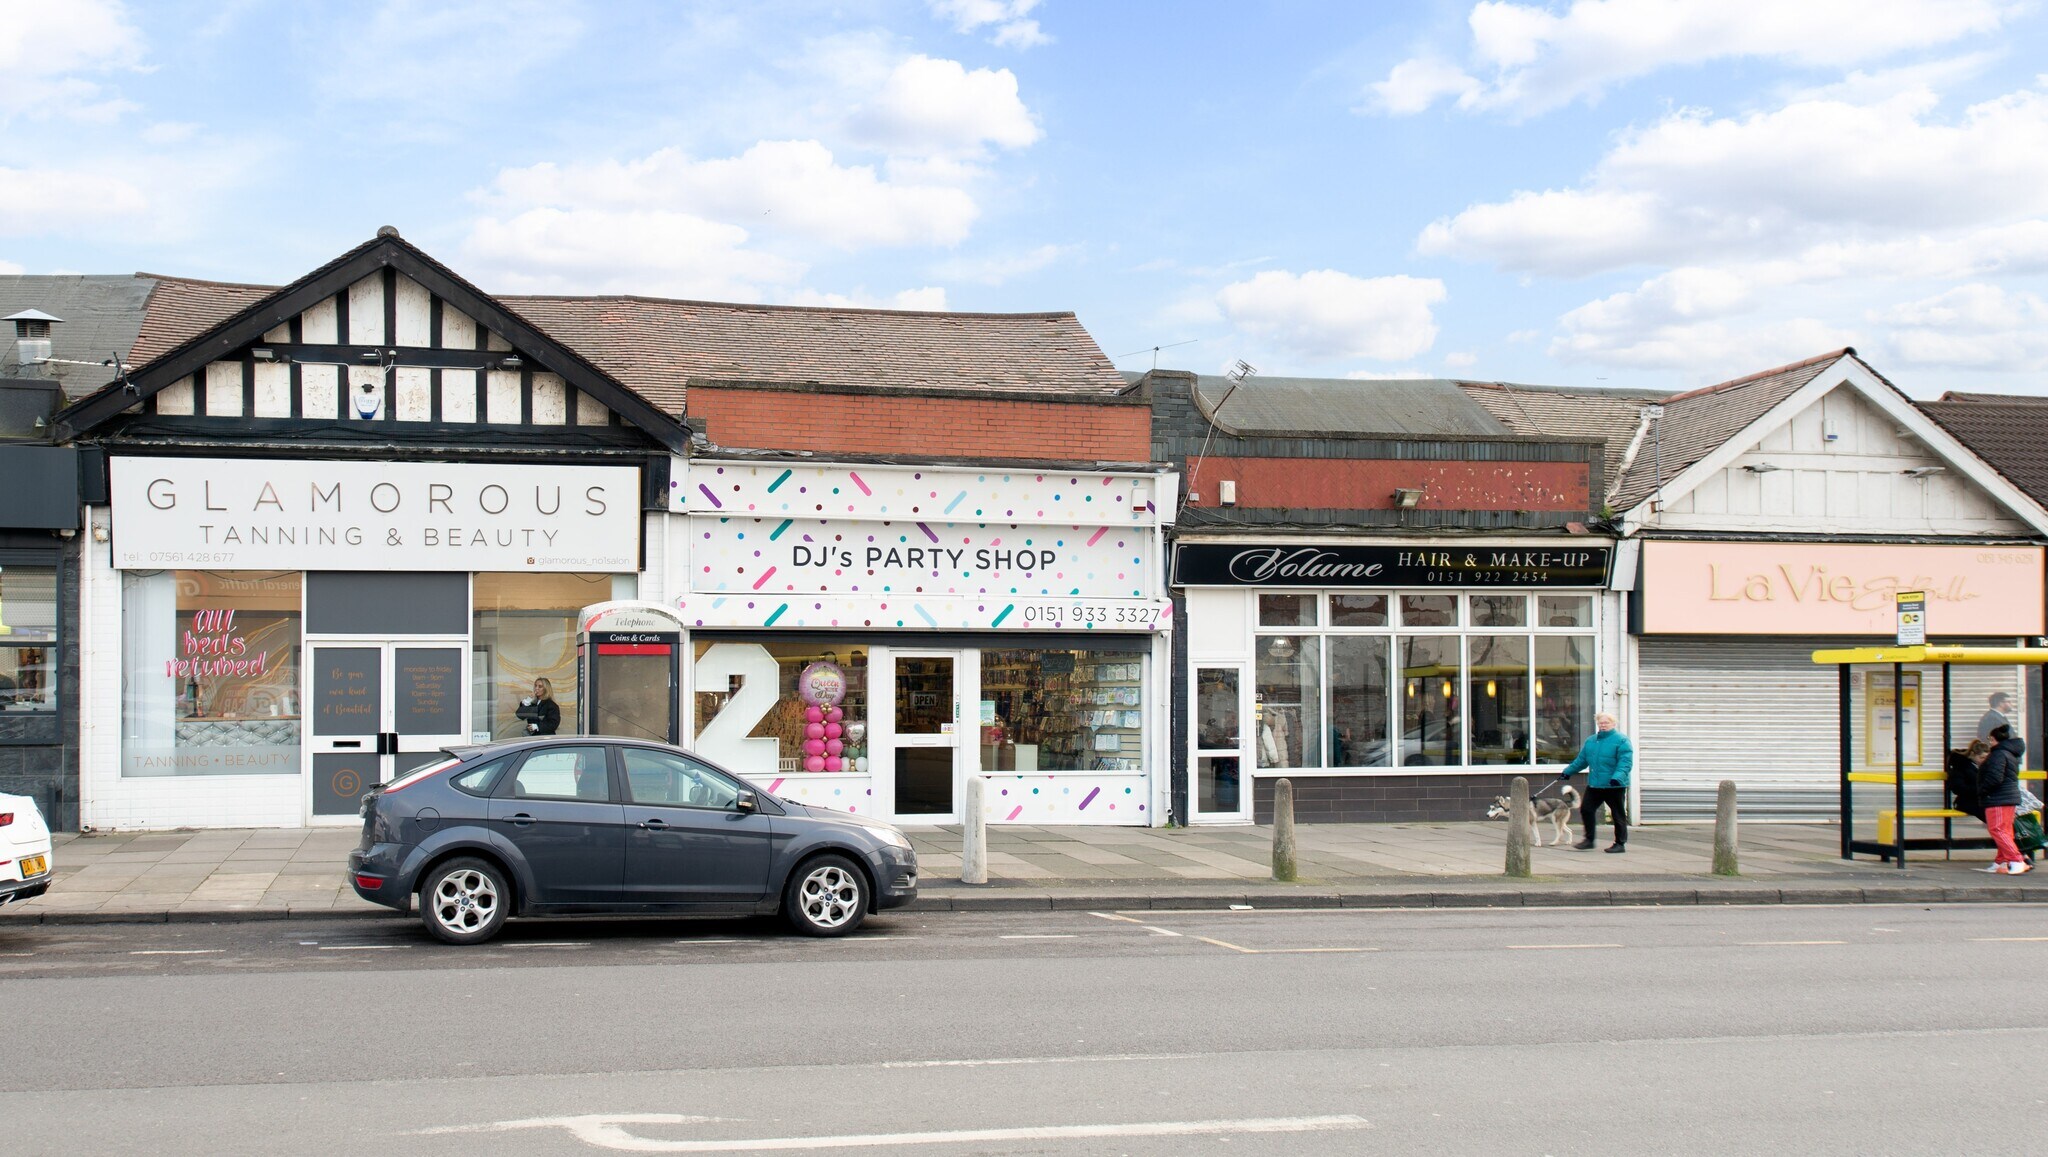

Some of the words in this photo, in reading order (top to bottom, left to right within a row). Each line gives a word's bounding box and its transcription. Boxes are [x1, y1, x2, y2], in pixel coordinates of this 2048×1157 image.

[147, 478, 607, 516] GLAMOROUS
[199, 525, 363, 546] TANNING
[386, 527, 403, 547] &
[424, 528, 559, 547] BEAUTY
[149, 551, 184, 562] 07561
[187, 552, 210, 562] 428
[213, 552, 235, 562] 677
[792, 545, 852, 568] DJ's
[866, 547, 964, 570] PARTY
[975, 550, 1056, 571] SHOP
[1397, 552, 1452, 567] HAIR
[1464, 553, 1477, 567] &
[1490, 552, 1590, 567] MAKE-UP
[1229, 547, 1384, 583] Volume
[1428, 571, 1463, 582] 0151
[1474, 571, 1501, 582] 922
[1512, 571, 1548, 582] 2454
[193, 608, 237, 634] all
[615, 617, 656, 628] Telephone
[1024, 606, 1064, 622] 0151
[1072, 606, 1107, 622] 933
[1115, 607, 1161, 624] 3327
[183, 629, 246, 657] beds
[610, 633, 630, 642] Coins
[631, 633, 638, 642] &
[639, 633, 661, 642] Cards
[811, 679, 840, 690] Queen
[815, 690, 837, 702] Day
[914, 695, 935, 705] OPEN
[133, 754, 209, 768] TANNING
[225, 753, 291, 767] BEAUTY
